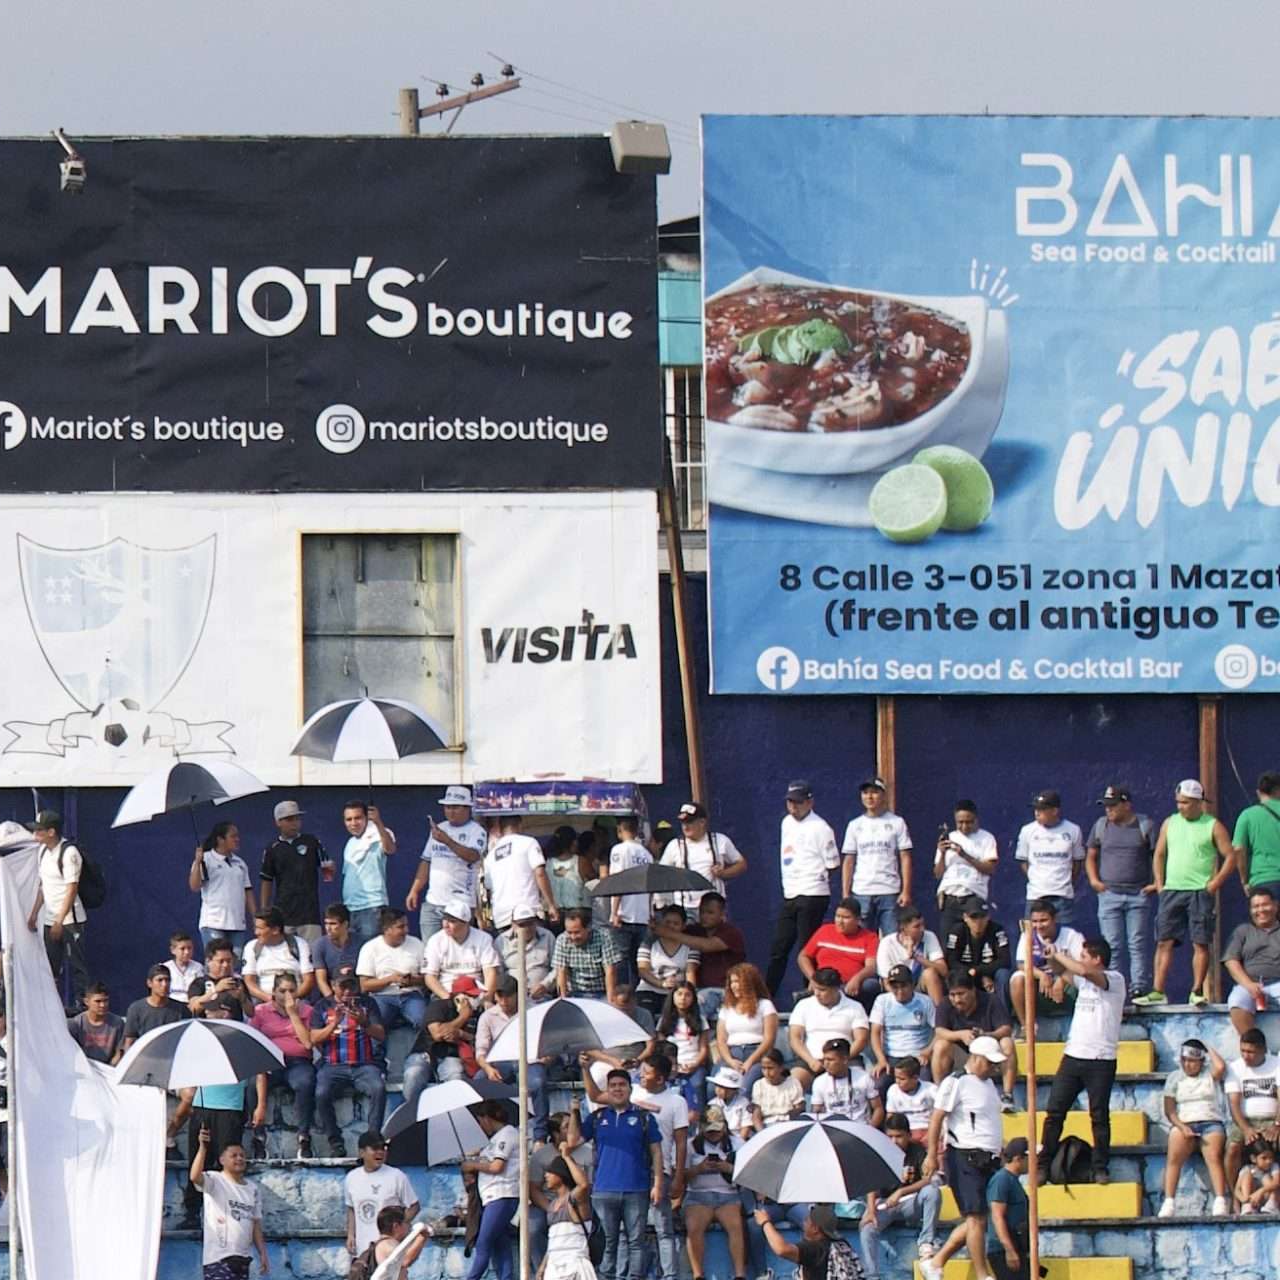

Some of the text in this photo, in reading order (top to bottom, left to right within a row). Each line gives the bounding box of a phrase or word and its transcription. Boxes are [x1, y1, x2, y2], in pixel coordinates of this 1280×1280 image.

[1031, 242, 1276, 263] Sea Food & Cocktail
[427, 302, 634, 342] boutique
[153, 415, 285, 446] boutique
[368, 415, 609, 447] mariotsboutique
[779, 564, 802, 592] 8
[812, 564, 914, 592] Calle
[924, 564, 1032, 592] 3-051
[1042, 567, 1137, 591] zona
[1146, 564, 1159, 590] 1
[824, 597, 1280, 640] (frente al antiguo Te
[480, 623, 638, 664] VISITA
[803, 657, 879, 681] Bahía
[884, 658, 933, 681] Sea
[939, 657, 1001, 681] Food
[1008, 658, 1029, 680] &
[1139, 657, 1183, 680] Bar
